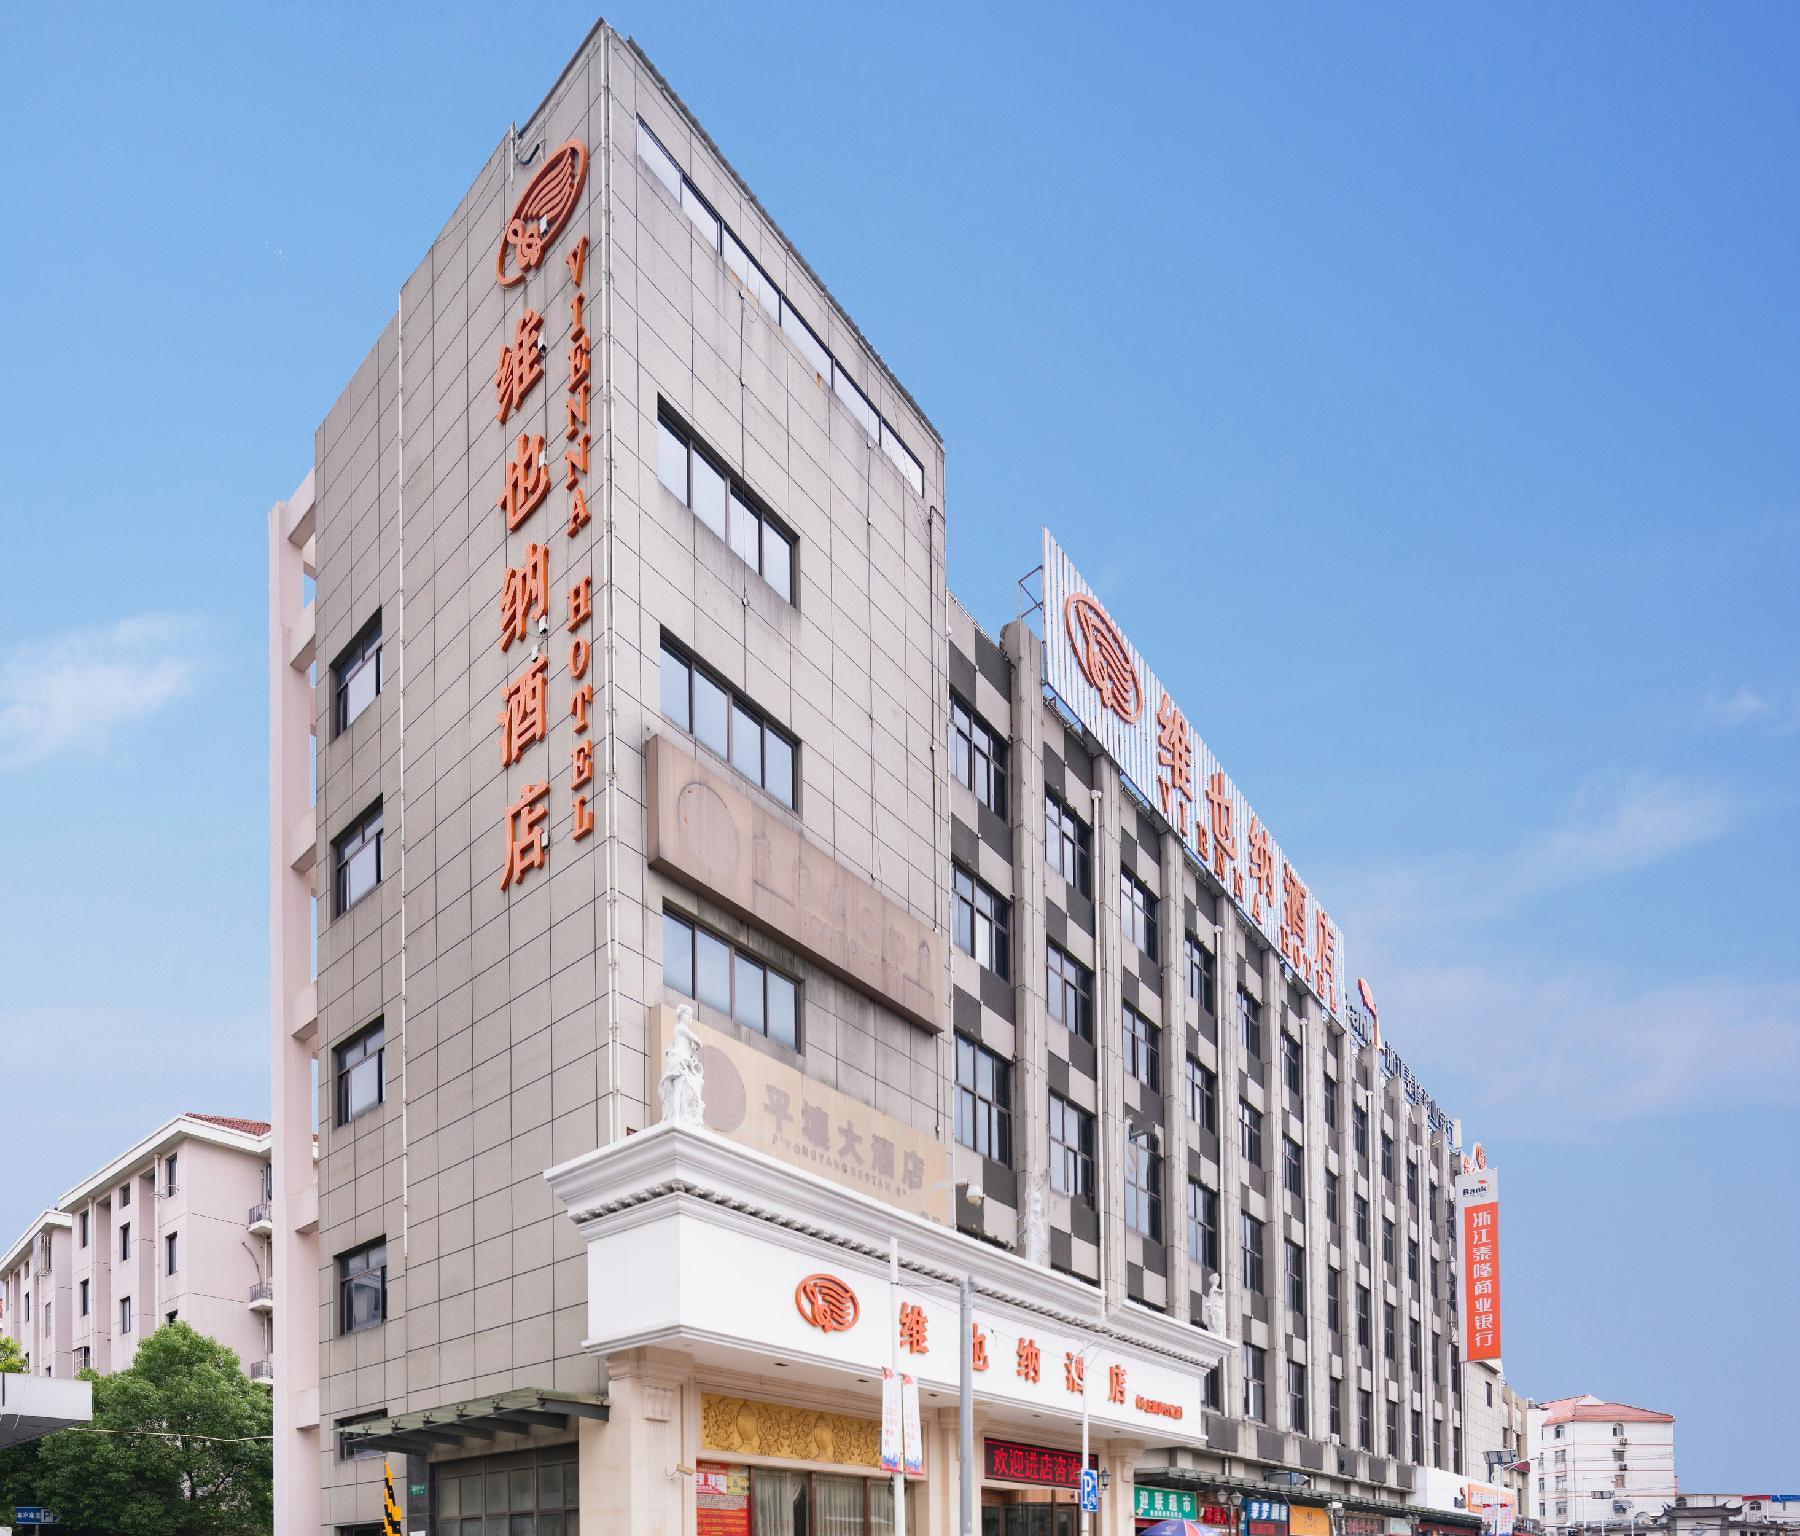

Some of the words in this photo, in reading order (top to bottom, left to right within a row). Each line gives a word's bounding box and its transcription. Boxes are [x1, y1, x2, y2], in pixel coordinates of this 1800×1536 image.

[566, 234, 590, 538] VIENNA
[496, 308, 551, 893] 维也纳酒店
[567, 575, 594, 842] HOTEL
[1157, 692, 1336, 985] 维也纳酒店
[1157, 774, 1262, 925] VIENNA
[1279, 924, 1338, 1014] HOTEL
[1462, 1185, 1488, 1197] Bank
[1472, 1211, 1494, 1348] 浙江泰隆商业银行
[899, 1302, 1127, 1404] 维也纳酒店
